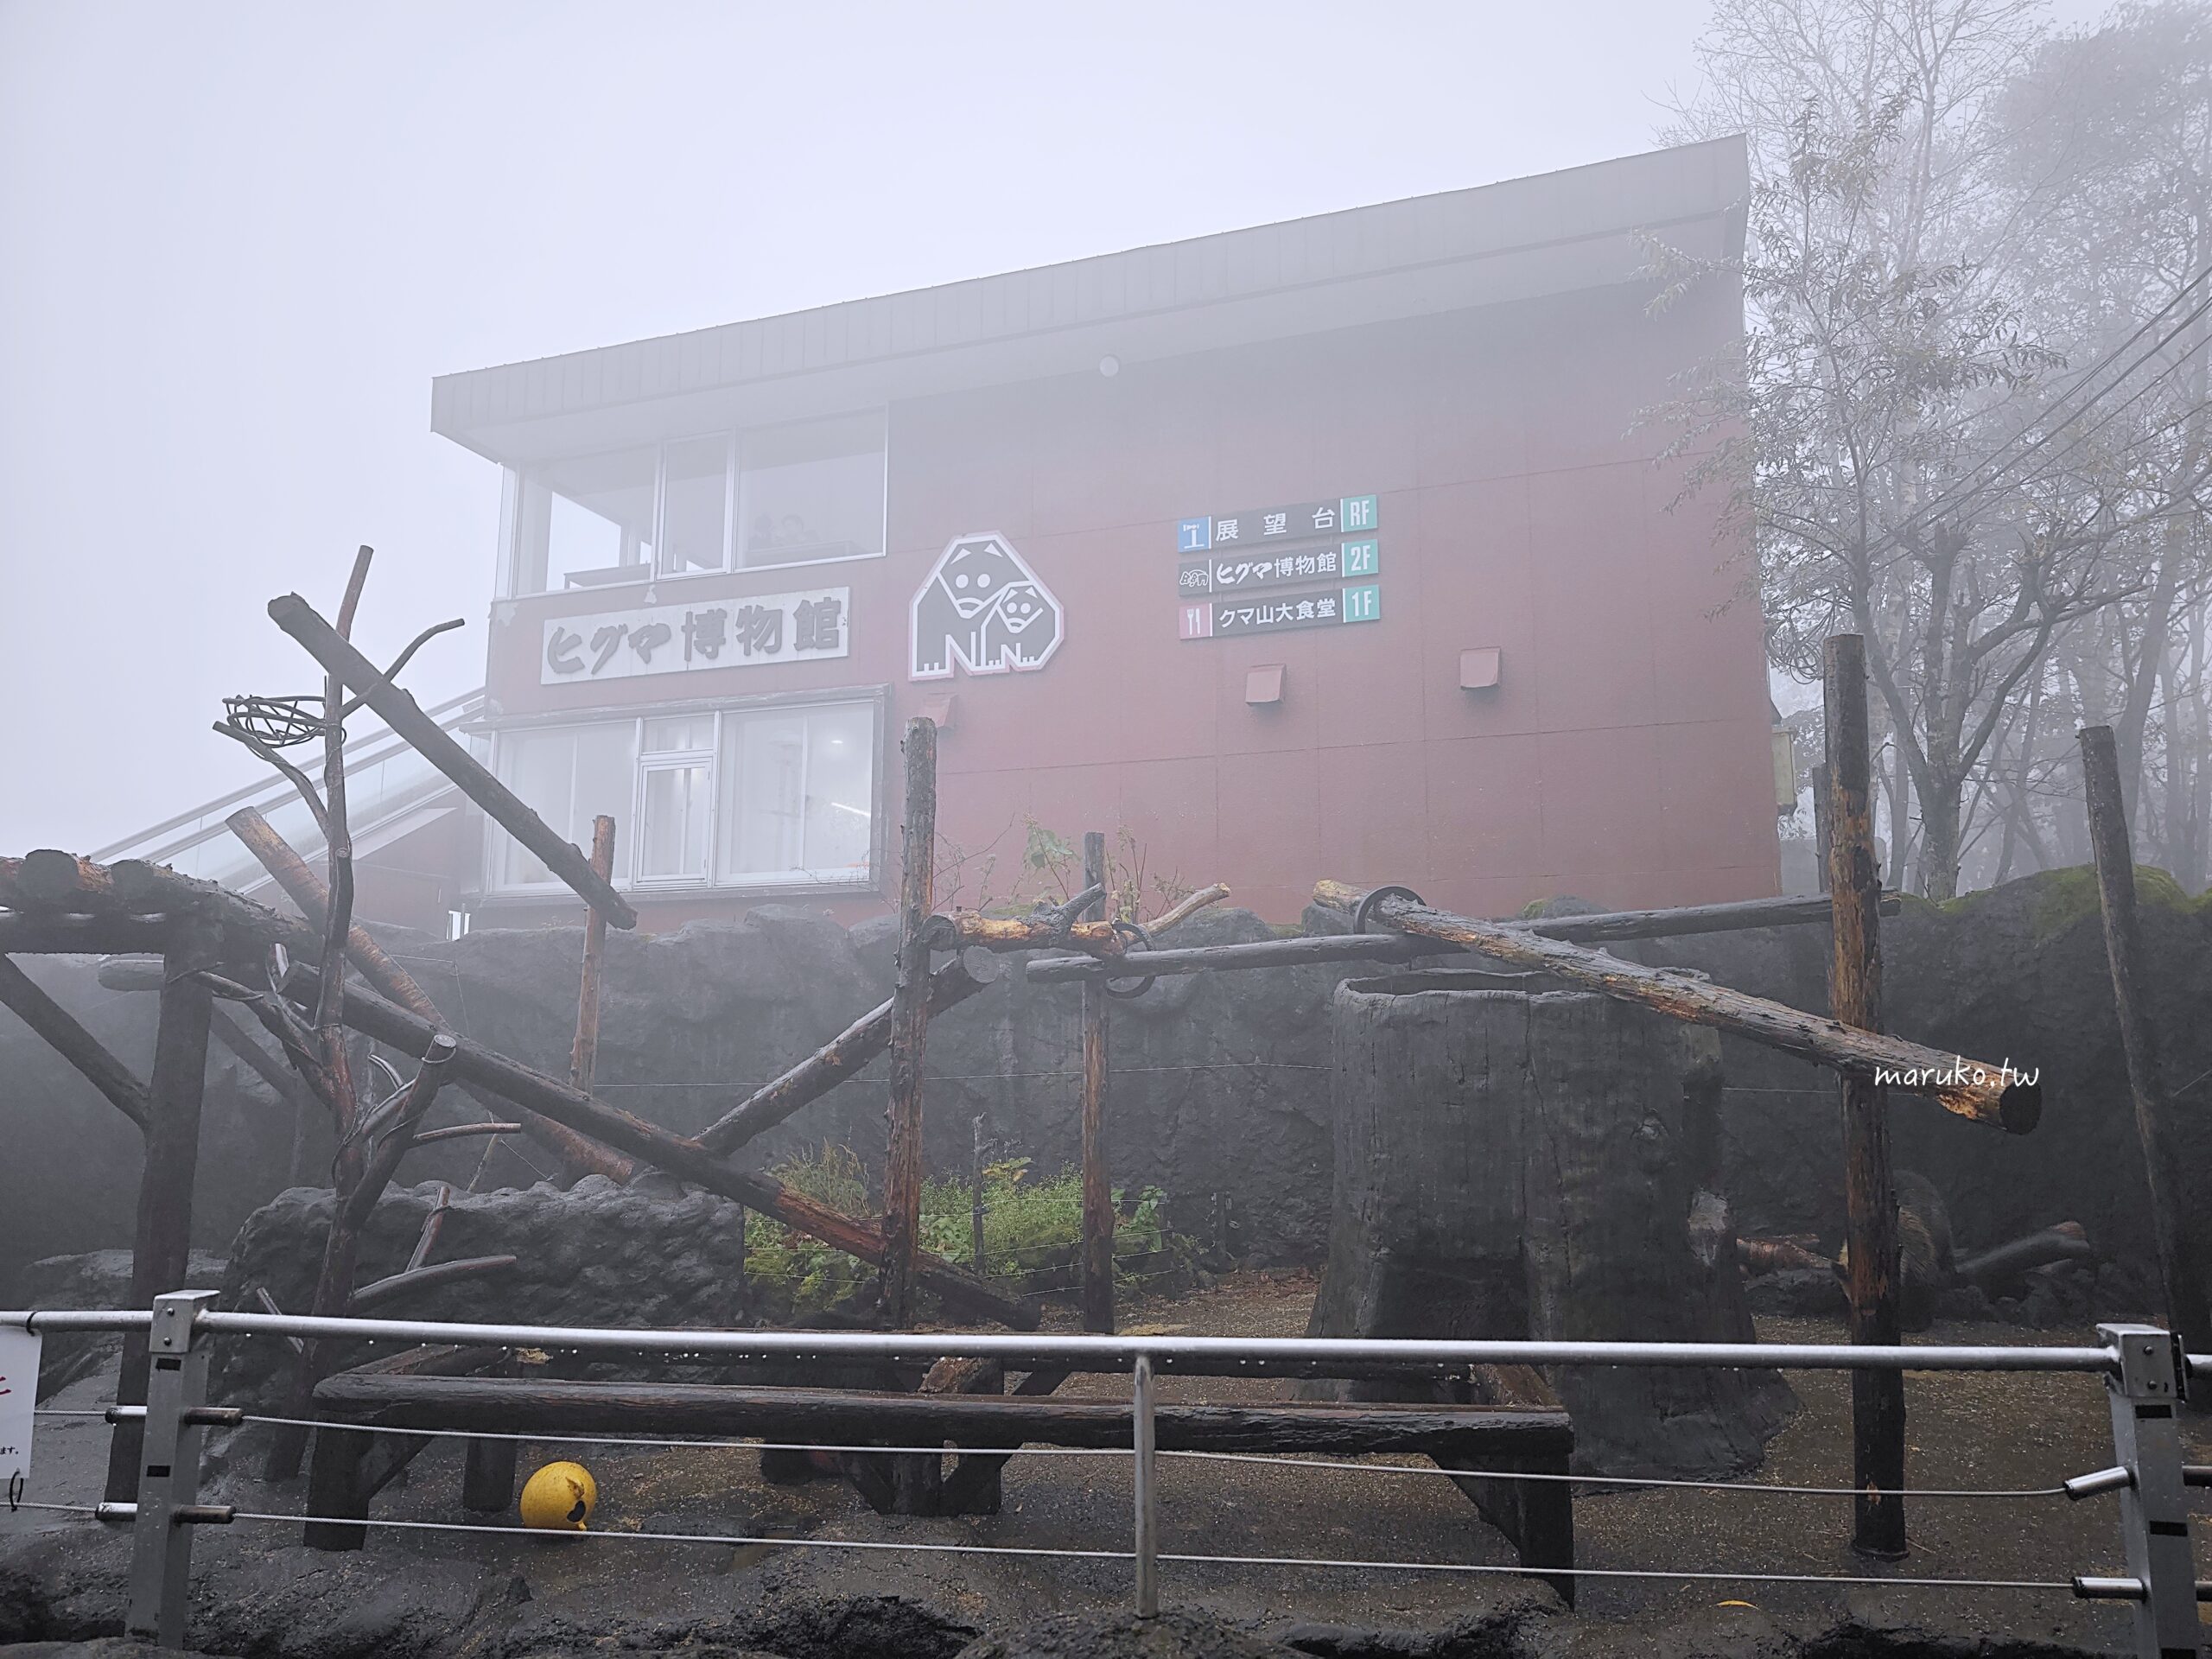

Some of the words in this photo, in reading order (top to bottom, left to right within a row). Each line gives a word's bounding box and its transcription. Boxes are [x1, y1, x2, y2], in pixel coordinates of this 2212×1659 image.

[1216, 507, 1336, 542] 展望台
[1350, 499, 1370, 527] RF
[1216, 551, 1337, 585] ヒグマ博物館
[1351, 544, 1371, 571] 2F
[1219, 598, 1336, 628] クマ山大食堂
[1351, 590, 1372, 617] 1F
[547, 596, 842, 674] ヒグマ博物館
